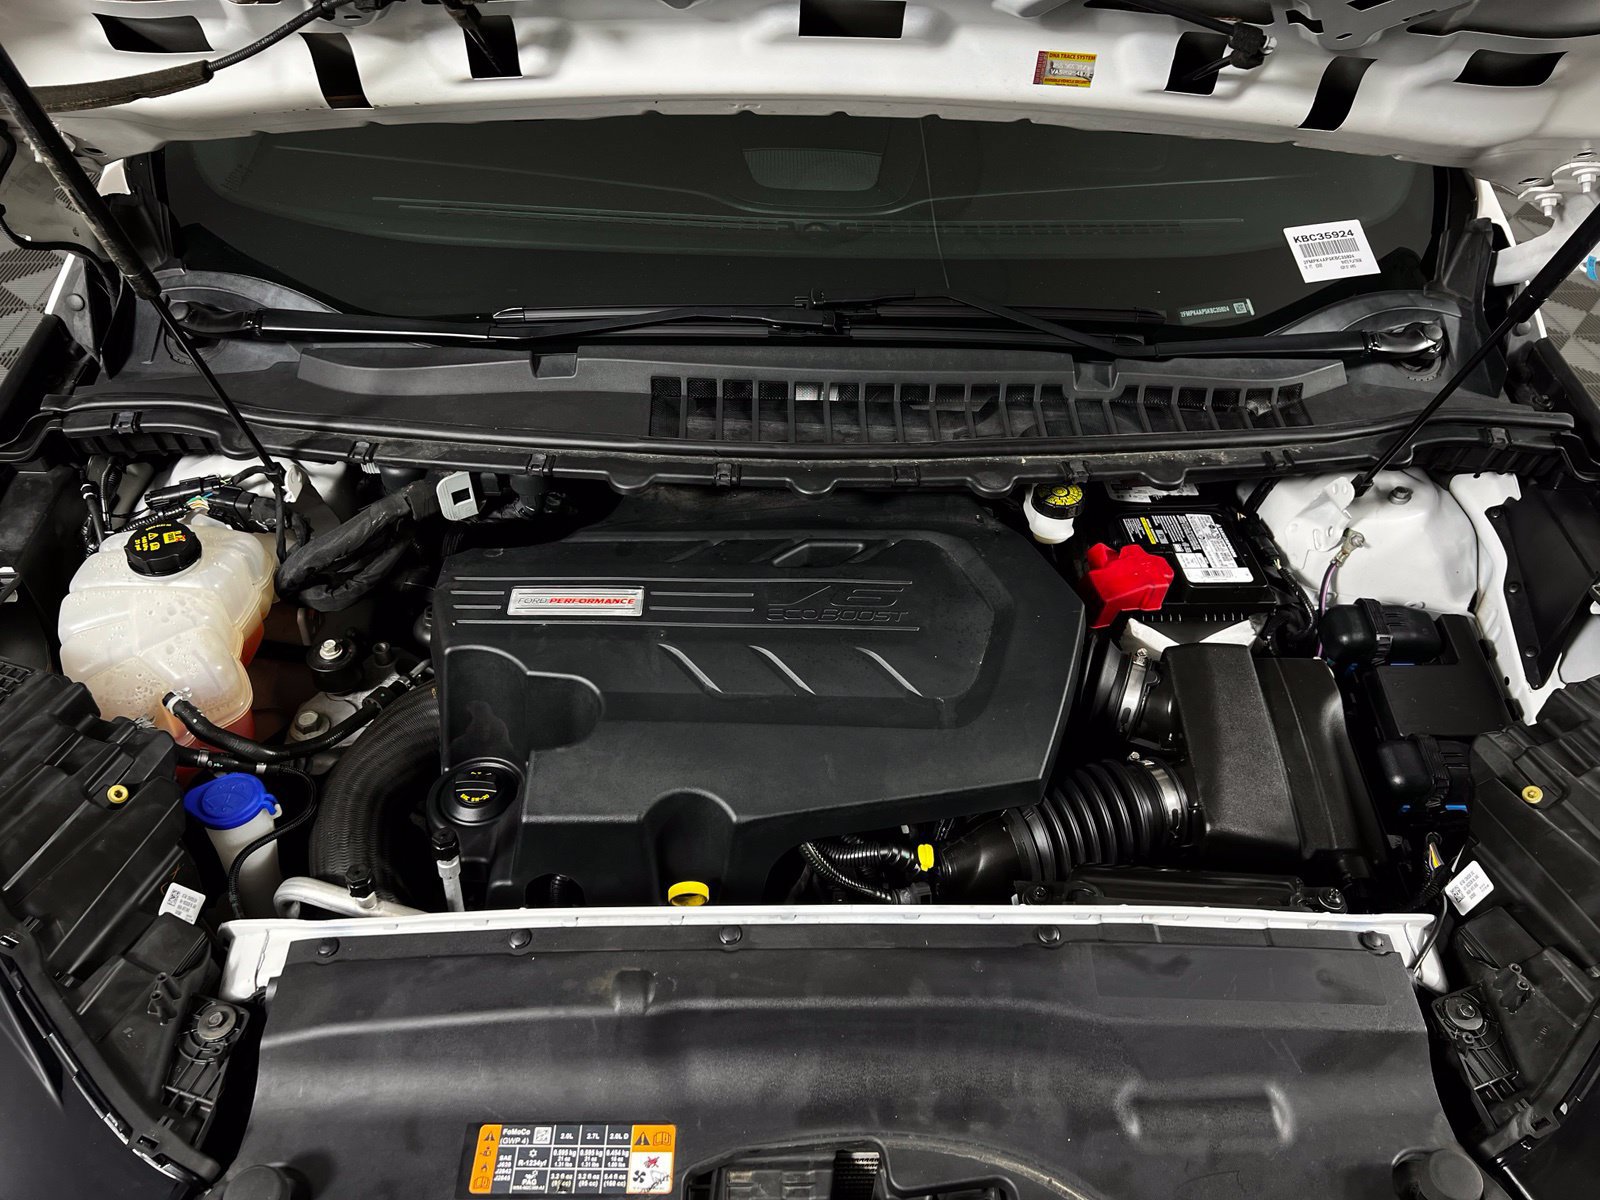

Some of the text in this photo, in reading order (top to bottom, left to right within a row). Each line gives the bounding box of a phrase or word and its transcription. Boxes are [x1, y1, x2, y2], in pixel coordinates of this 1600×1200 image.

[1293, 230, 1354, 243] KBC35924
[766, 608, 908, 622] ECOBOOST
[518, 1160, 547, 1168] R-1234yf
